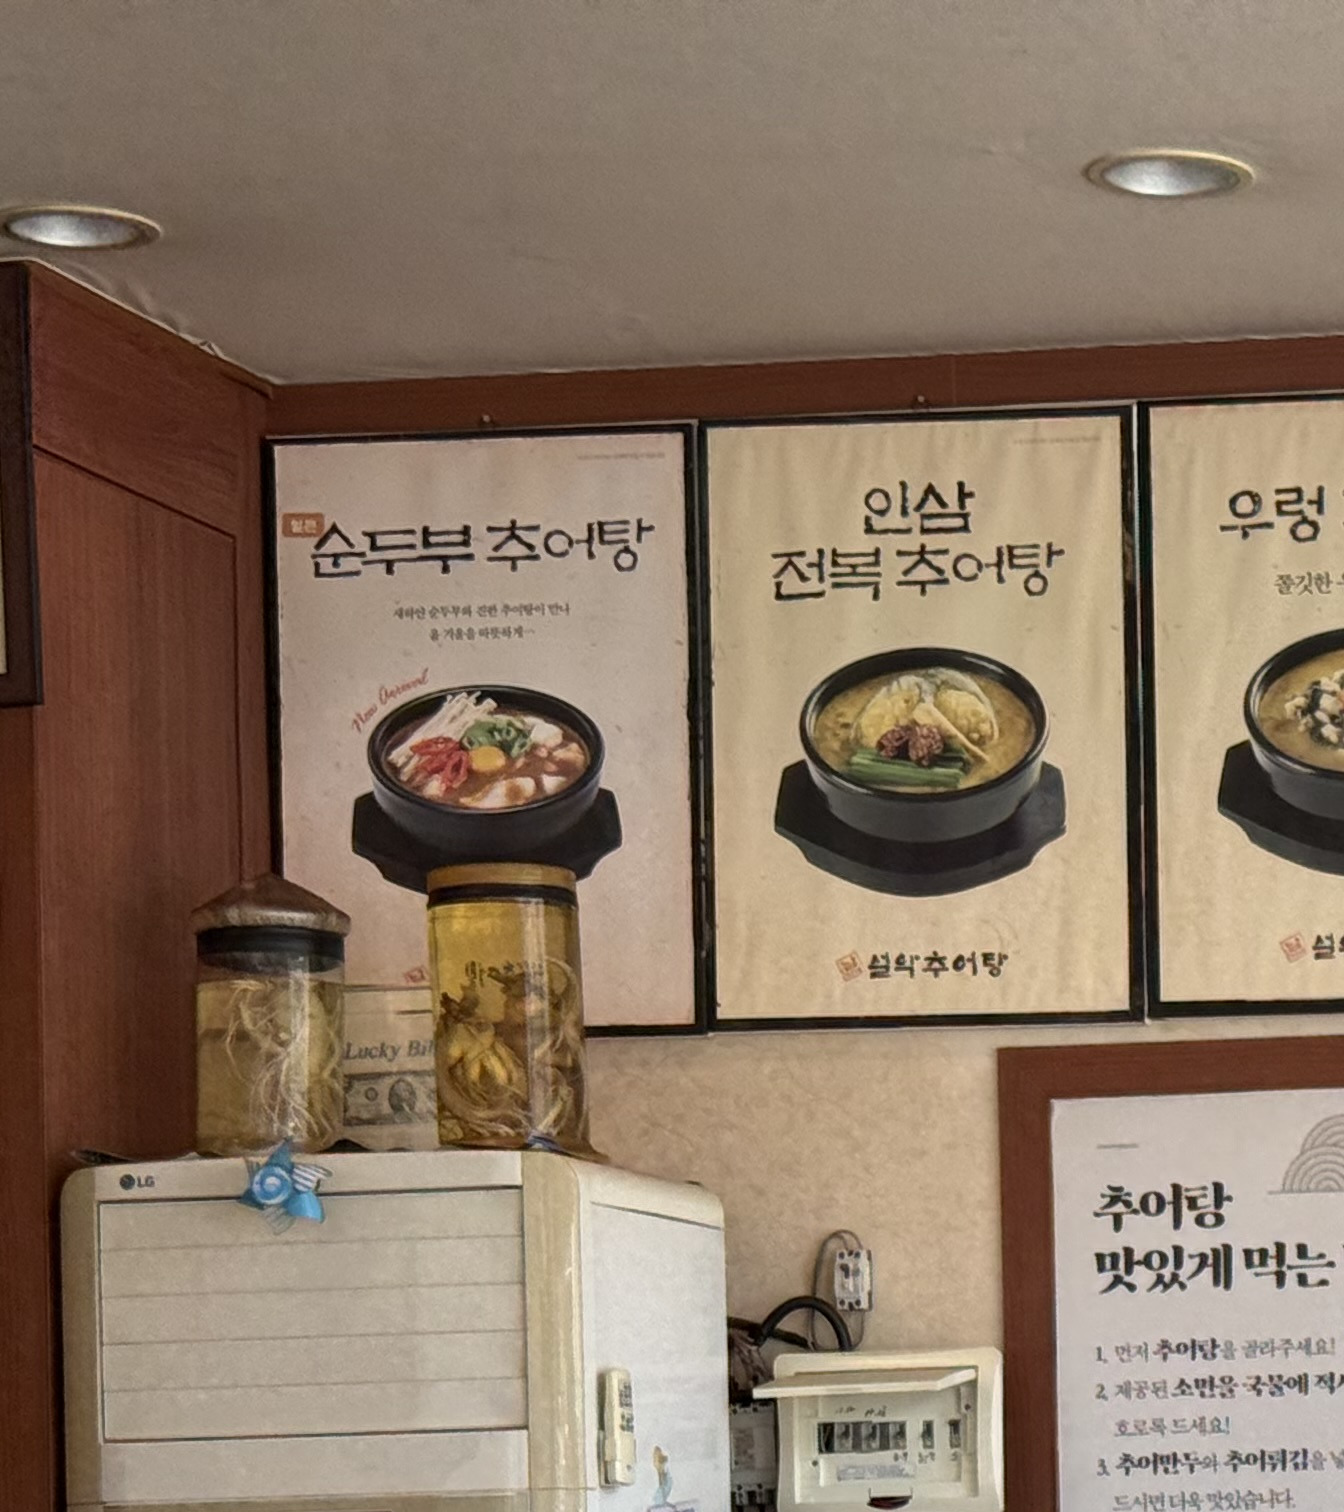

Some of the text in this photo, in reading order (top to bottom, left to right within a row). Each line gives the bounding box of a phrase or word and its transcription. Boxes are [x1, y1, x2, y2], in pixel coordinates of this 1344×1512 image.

[864, 480, 976, 535] 인삼
[1219, 484, 1326, 544] 우렁
[310, 518, 656, 579] 순두부 추어탕
[771, 542, 1065, 601] 전복 추어탕
[867, 952, 1009, 979] 설악추어탕
[343, 1041, 401, 1062] Lucky
[136, 1174, 156, 1189] LG
[1093, 1180, 1234, 1234] 추어탕
[1094, 1242, 1233, 1295] 맛있게
[1242, 1240, 1336, 1290] 먹는
[1095, 1346, 1108, 1364] 1.
[1115, 1341, 1149, 1363] 먼저
[1152, 1337, 1238, 1363] 추어탕을
[1115, 1380, 1168, 1401] 제공된
[1171, 1374, 1239, 1399] 소면을
[1242, 1372, 1309, 1397] 국물에
[1115, 1451, 1219, 1477] 추어만두와
